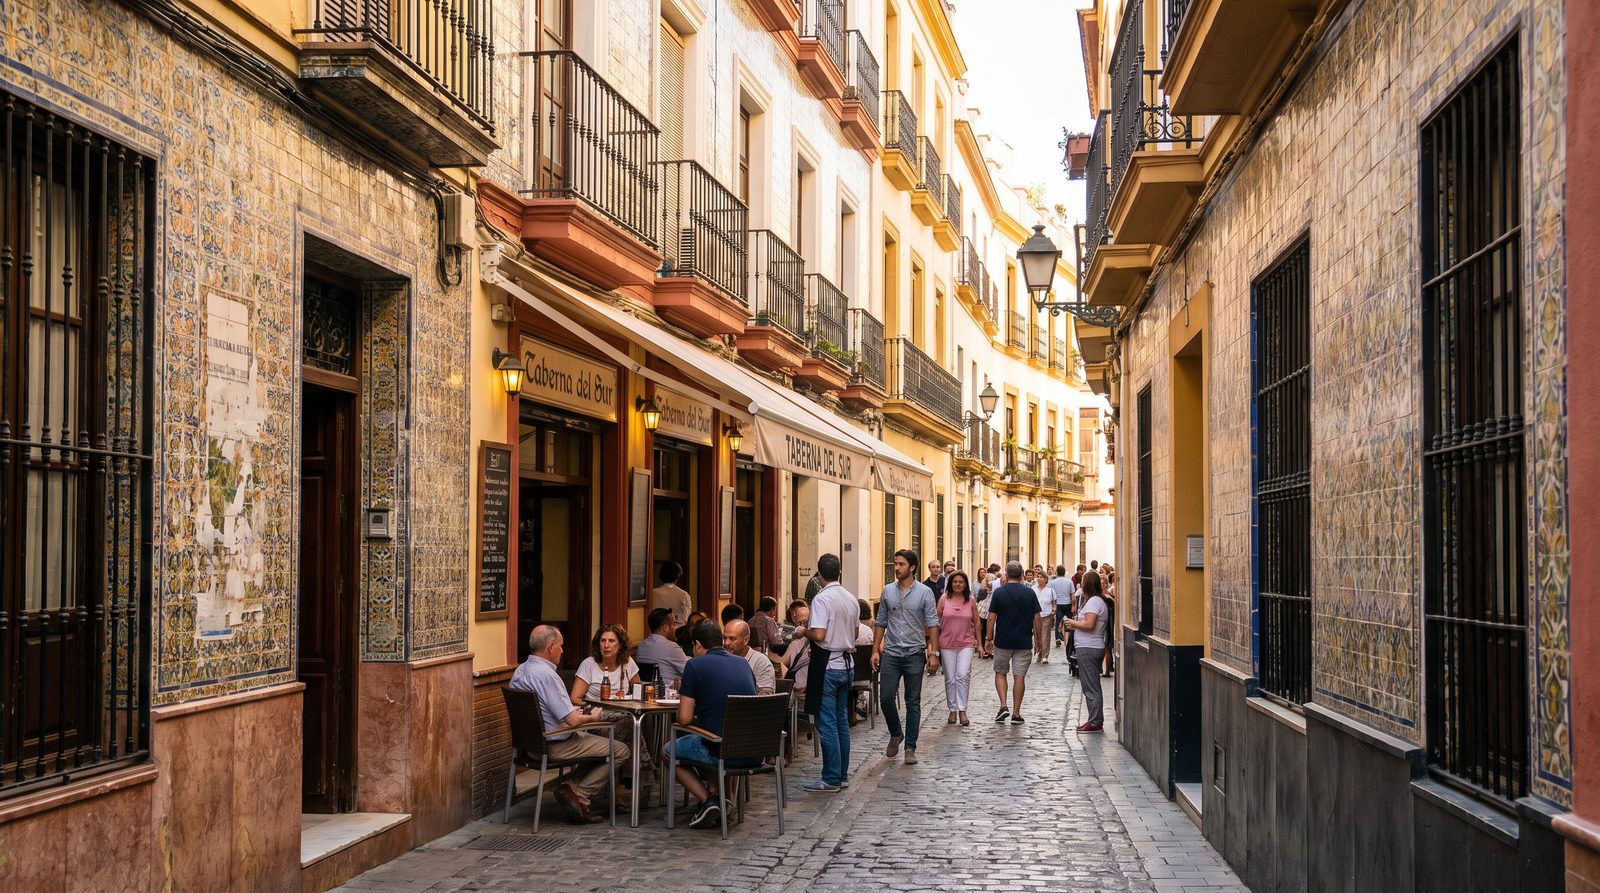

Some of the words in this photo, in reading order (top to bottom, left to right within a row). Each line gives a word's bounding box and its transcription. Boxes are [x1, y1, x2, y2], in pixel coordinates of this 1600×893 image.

[525, 350, 573, 395] Taberna
[576, 370, 591, 400] del
[785, 434, 822, 473] TABERNA
[823, 448, 836, 477] DEL
[838, 453, 852, 481] SUR
